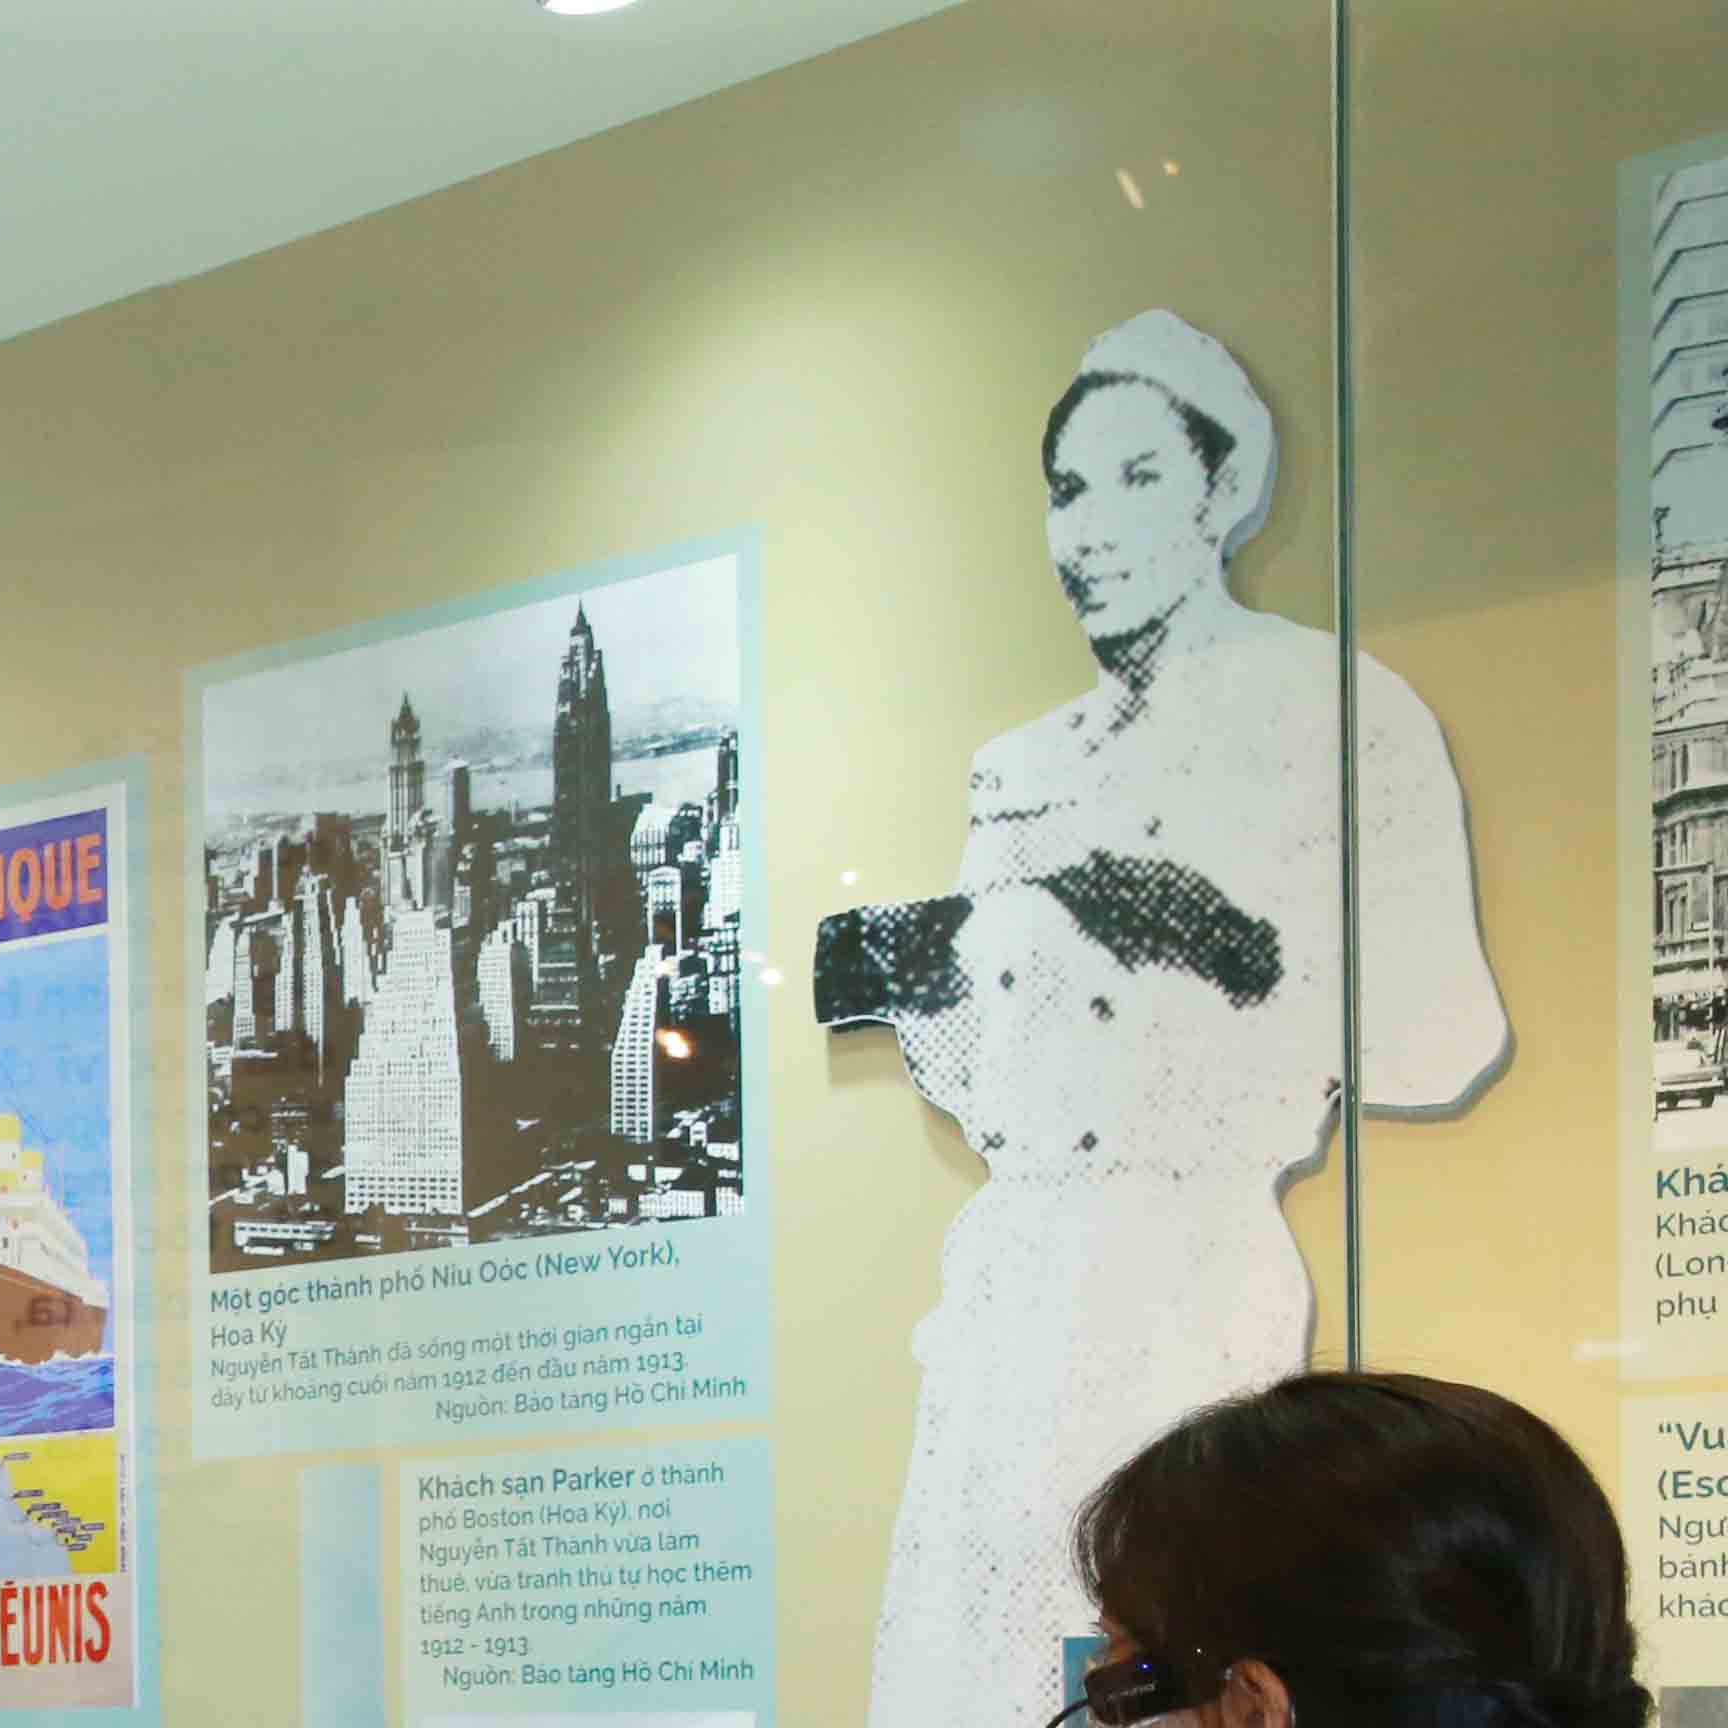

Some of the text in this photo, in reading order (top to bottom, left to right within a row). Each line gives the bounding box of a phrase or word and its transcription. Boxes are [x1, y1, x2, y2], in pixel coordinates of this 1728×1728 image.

[1656, 1163, 1728, 1199] Khá
[210, 1287, 252, 1317] Một
[258, 1282, 300, 1313] góc
[306, 1274, 373, 1302] thành
[380, 1267, 425, 1300] phố
[431, 1264, 472, 1289] Niu
[535, 1249, 601, 1282] (New
[1656, 1252, 1728, 1279] (Lon
[1656, 1291, 1717, 1325] phụ
[210, 1326, 254, 1348] Hoa
[210, 1351, 283, 1382] Nguyễn
[287, 1348, 317, 1369] Tất
[323, 1343, 382, 1366] Thành
[416, 1335, 465, 1364] sống
[471, 1333, 513, 1358] một
[518, 1328, 558, 1350] thời
[563, 1324, 608, 1352] gian
[675, 1316, 704, 1341] tại
[347, 1372, 389, 1395] cuối
[394, 1370, 437, 1391] năm
[442, 1370, 487, 1391] 1912
[493, 1360, 532, 1383] đến
[536, 1357, 577, 1379] đầu
[583, 1354, 630, 1375] năm
[513, 1391, 555, 1413] Bảo
[559, 1387, 609, 1416] tàng
[614, 1383, 645, 1406] Hồ
[650, 1381, 687, 1403] Chí
[691, 1377, 747, 1400] Minh
[1658, 1421, 1728, 1450] “Vu
[418, 1474, 494, 1500] Khách
[501, 1478, 545, 1500] sạn
[552, 1466, 636, 1493] Parker
[660, 1461, 725, 1487] thành
[418, 1506, 458, 1536] phố
[463, 1505, 535, 1527] Boston
[539, 1501, 588, 1528] (Hoa
[637, 1499, 672, 1519] nơi
[1659, 1515, 1728, 1545] Ngư
[419, 1529, 700, 1567] Nguyễn Tất Thành vừa làm
[474, 1570, 513, 1591] vừa
[517, 1568, 573, 1589] tranh
[577, 1566, 613, 1587] thủ
[618, 1566, 642, 1590] tự
[647, 1564, 688, 1589] học
[692, 1561, 753, 1583] thêm
[419, 1596, 707, 1631] tiếng Anh trong những năm
[420, 1638, 464, 1657] 1912
[521, 1664, 561, 1683] Bảo
[567, 1663, 616, 1689] tàng
[621, 1661, 652, 1682] Hồ
[658, 1661, 693, 1681] Chí
[699, 1660, 754, 1681] Minh
